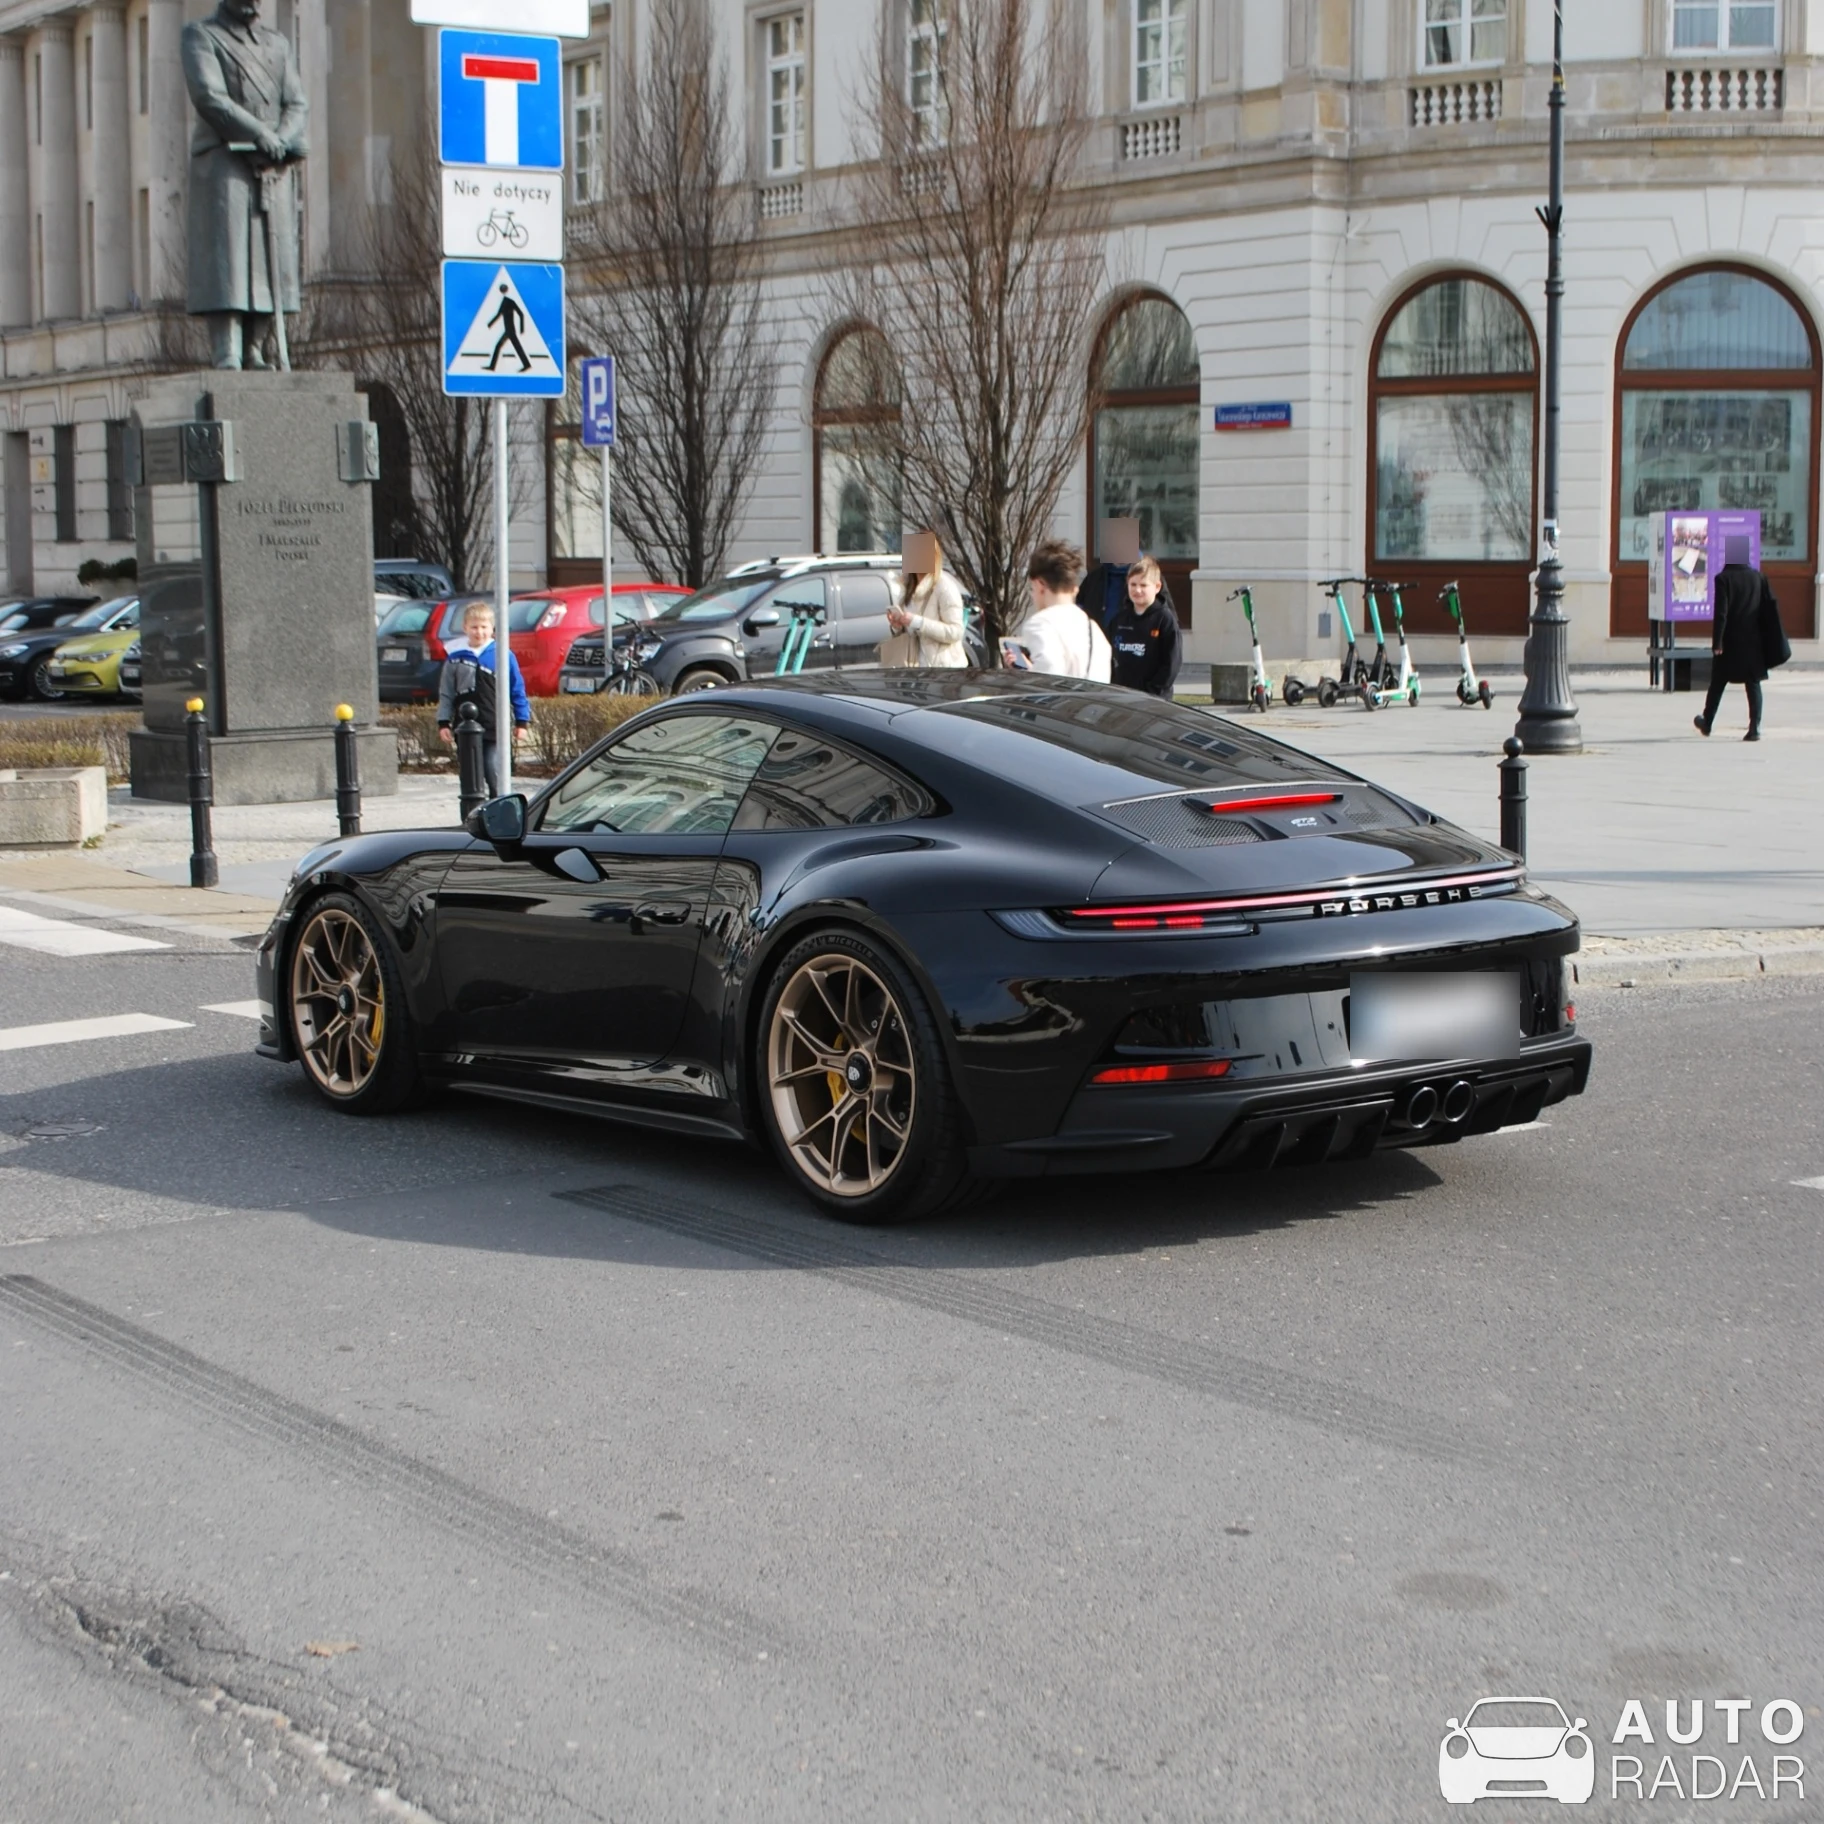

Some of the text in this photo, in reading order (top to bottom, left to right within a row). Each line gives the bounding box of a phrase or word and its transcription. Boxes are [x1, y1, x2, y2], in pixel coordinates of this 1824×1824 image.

[454, 180, 551, 205] Nie dotyczy
[588, 366, 608, 421] P
[1320, 886, 1483, 917] PORSCHE
[828, 936, 874, 958] MICHELIN
